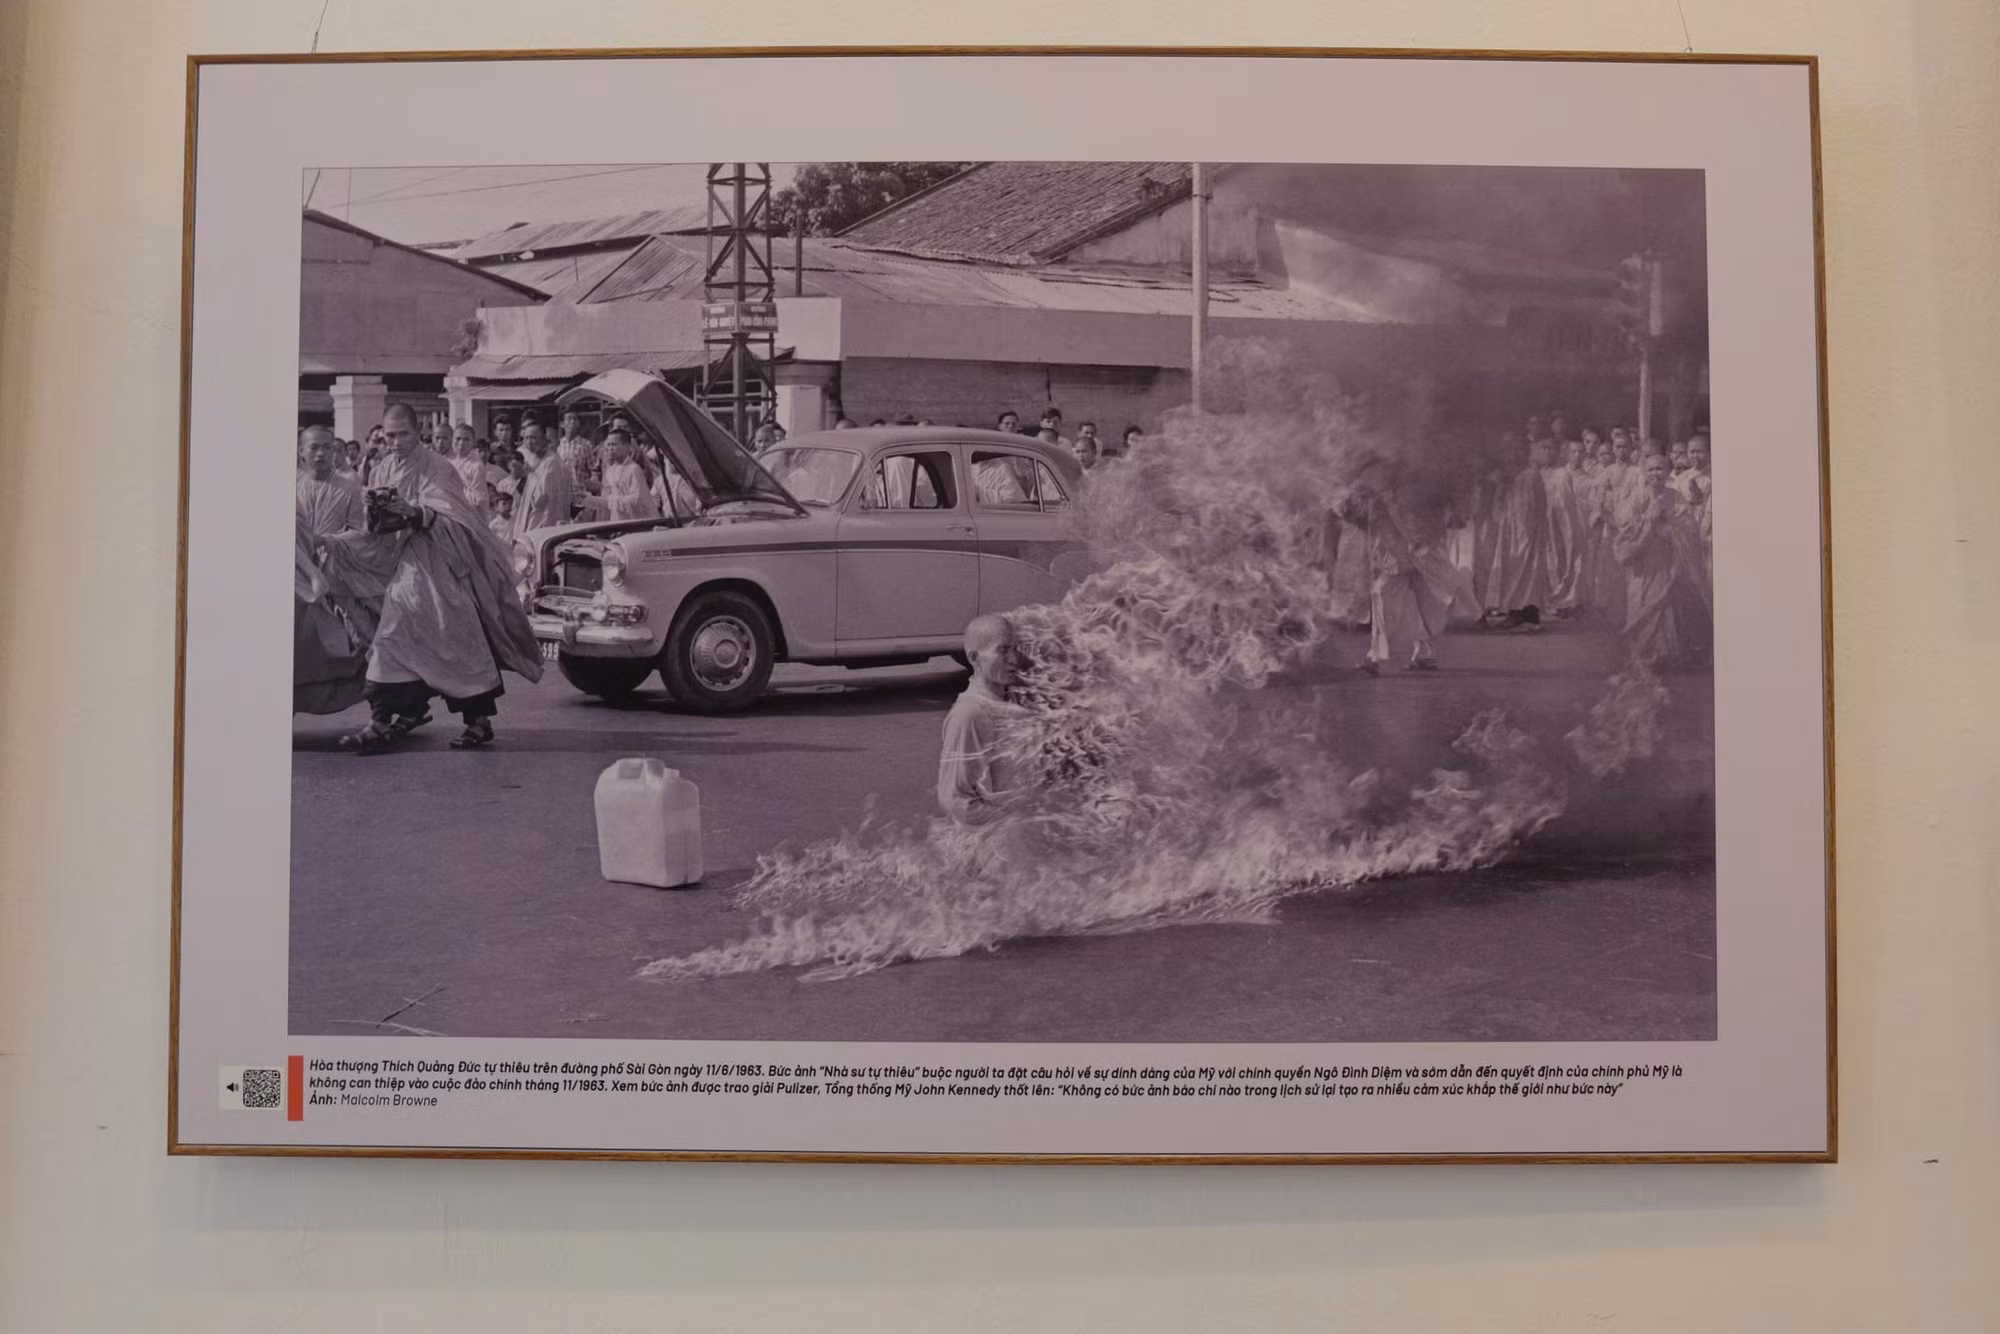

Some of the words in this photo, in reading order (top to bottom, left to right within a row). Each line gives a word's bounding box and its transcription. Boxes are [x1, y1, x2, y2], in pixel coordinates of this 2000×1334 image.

[310, 1059, 333, 1071] Hòa
[336, 1060, 378, 1074] thượng
[382, 1060, 414, 1072] Thích
[417, 1060, 455, 1075] Quảng
[458, 1061, 481, 1072] Đức
[484, 1062, 497, 1075] tự
[500, 1061, 530, 1073] thiêu
[533, 1062, 558, 1073] trên
[561, 1062, 598, 1077] đường
[600, 1062, 625, 1077] phố
[626, 1063, 645, 1075] Sài
[648, 1063, 671, 1075] Gòn
[674, 1064, 703, 1078] ngày
[706, 1064, 764, 1076] 11/6/1963.
[768, 1065, 791, 1076] Bức
[794, 1064, 816, 1077] ảnh
[851, 1067, 867, 1077] sư
[868, 1067, 882, 1080] tự
[922, 1066, 952, 1080] buộc
[955, 1066, 989, 1081] người
[992, 1067, 1005, 1078] ta
[1008, 1067, 1028, 1081] đặt
[1031, 1067, 1053, 1078] câu
[1055, 1066, 1075, 1079] hỏi
[1077, 1065, 1092, 1079] về
[1094, 1067, 1110, 1081] sự
[1111, 1067, 1137, 1079] dính
[1140, 1067, 1170, 1081] dáng
[1173, 1066, 1195, 1079] của
[1198, 1067, 1216, 1081] Mỹ
[1218, 1066, 1236, 1079] với
[1238, 1067, 1271, 1079] chính
[1274, 1065, 1311, 1081] quyền
[1314, 1066, 1338, 1081] Ngô
[1342, 1066, 1368, 1078] Đình
[1371, 1066, 1402, 1081] Diệm
[1405, 1066, 1419, 1078] và
[1421, 1066, 1447, 1078] sớm
[1450, 1064, 1472, 1078] dẫn
[1476, 1065, 1498, 1078] đến
[1501, 1065, 1535, 1080] quyết
[1538, 1065, 1563, 1080] định
[1566, 1065, 1589, 1077] của
[1592, 1065, 1624, 1077] chính
[1626, 1064, 1649, 1080] phủ
[1652, 1065, 1669, 1079] Mỹ
[1672, 1065, 1682, 1077] là
[309, 1090, 337, 1105] Ảnh:
[341, 1094, 390, 1105] Malcolm
[393, 1094, 437, 1106] Browne
[310, 1076, 346, 1091] không
[349, 1079, 371, 1088] can
[375, 1077, 405, 1091] thiệp
[409, 1077, 429, 1089] vào
[432, 1078, 461, 1092] cuộc
[464, 1077, 486, 1090] đảo
[489, 1079, 522, 1090] chính
[525, 1079, 559, 1093] tháng
[563, 1080, 608, 1091] 11/1963.
[611, 1080, 638, 1092] Xem
[641, 1080, 663, 1092] bức
[666, 1080, 688, 1092] ảnh
[691, 1081, 721, 1095] được
[724, 1082, 749, 1093] trao
[752, 1081, 774, 1096] giải
[777, 1082, 820, 1095] Pulizer,
[825, 1080, 854, 1097] Tổng
[857, 1082, 892, 1098] thống
[895, 1083, 912, 1098] Mỹ
[914, 1084, 945, 1095] John
[948, 1084, 1001, 1098] Kennedy
[1004, 1083, 1029, 1096] thốt
[1032, 1084, 1054, 1096] lên:
[1104, 1084, 1119, 1096] có
[1122, 1084, 1145, 1096] bức
[1147, 1084, 1170, 1096] ảnh
[1172, 1084, 1195, 1096] báo
[1198, 1084, 1217, 1096] chí
[1219, 1084, 1241, 1096] nào
[1245, 1085, 1277, 1098] trong
[1280, 1084, 1302, 1098] lịch
[1305, 1083, 1321, 1095] sử
[1322, 1083, 1336, 1098] lại
[1339, 1084, 1358, 1098] tạo
[1361, 1086, 1374, 1095] ra
[1377, 1081, 1410, 1095] nhiều
[1413, 1083, 1439, 1095] cảm
[1442, 1083, 1464, 1095] xúc
[1466, 1081, 1496, 1098] khắp
[1499, 1082, 1520, 1095] thế
[1522, 1083, 1544, 1097] giới
[1546, 1083, 1570, 1094] như
[1572, 1083, 1594, 1094] bức
